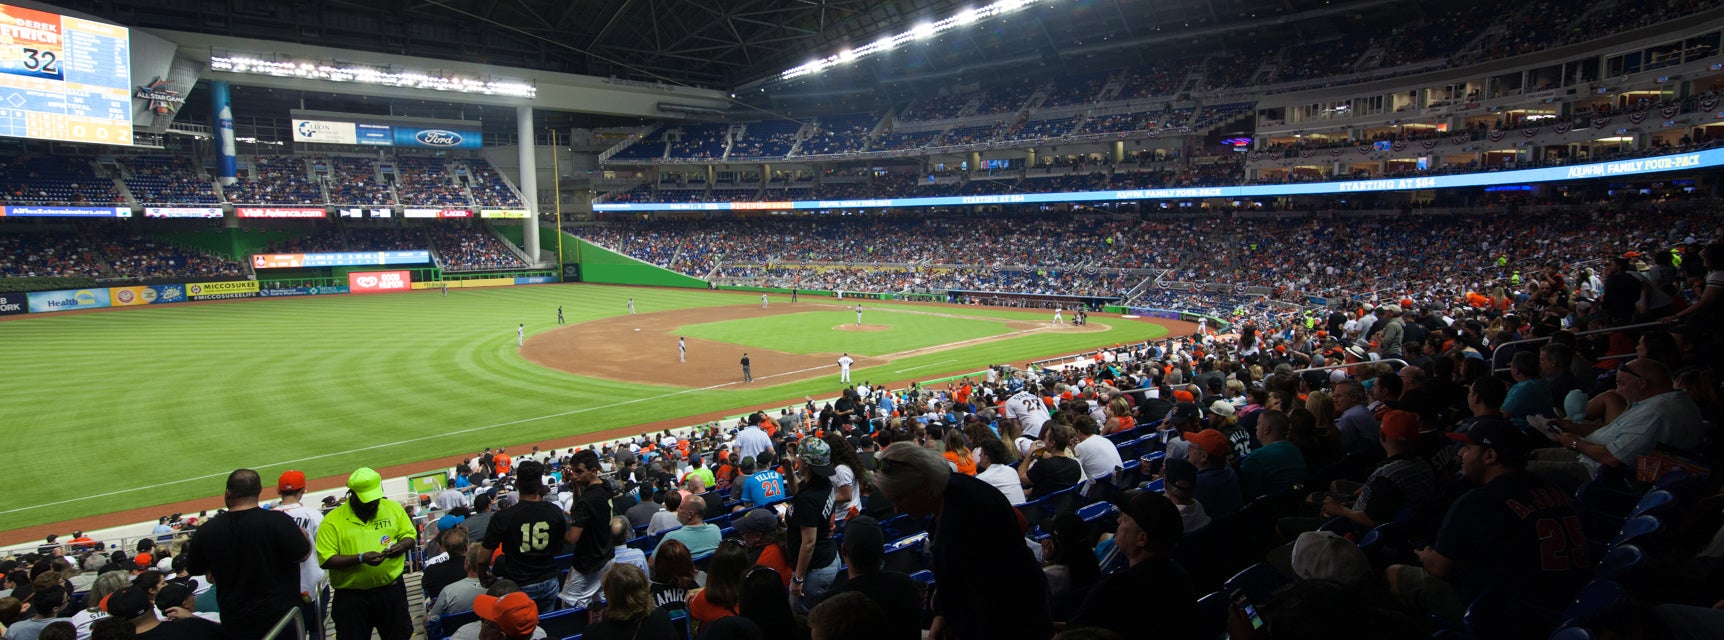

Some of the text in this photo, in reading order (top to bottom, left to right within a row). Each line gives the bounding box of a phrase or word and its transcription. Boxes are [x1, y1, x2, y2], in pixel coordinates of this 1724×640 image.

[16, 18, 57, 32] DEREK
[23, 47, 58, 74] 32
[73, 125, 128, 141] 0 0 2
[424, 131, 454, 146] Ford
[1607, 161, 1643, 174] FAMILY
[1644, 154, 1700, 171] FOUR-PACK
[1339, 177, 1435, 192] STARTING AT $84
[962, 196, 999, 204] STARTING
[1000, 195, 1009, 203] AT
[1145, 189, 1175, 198] FAMILY
[1176, 188, 1222, 197] FOUR-PACK
[242, 208, 322, 218] Visit Avianca.com
[203, 281, 256, 290] MICCOSUKEE
[762, 480, 781, 497] 21
[374, 520, 392, 530] 2171
[519, 521, 550, 553] 16
[656, 588, 687, 607] AMIR
